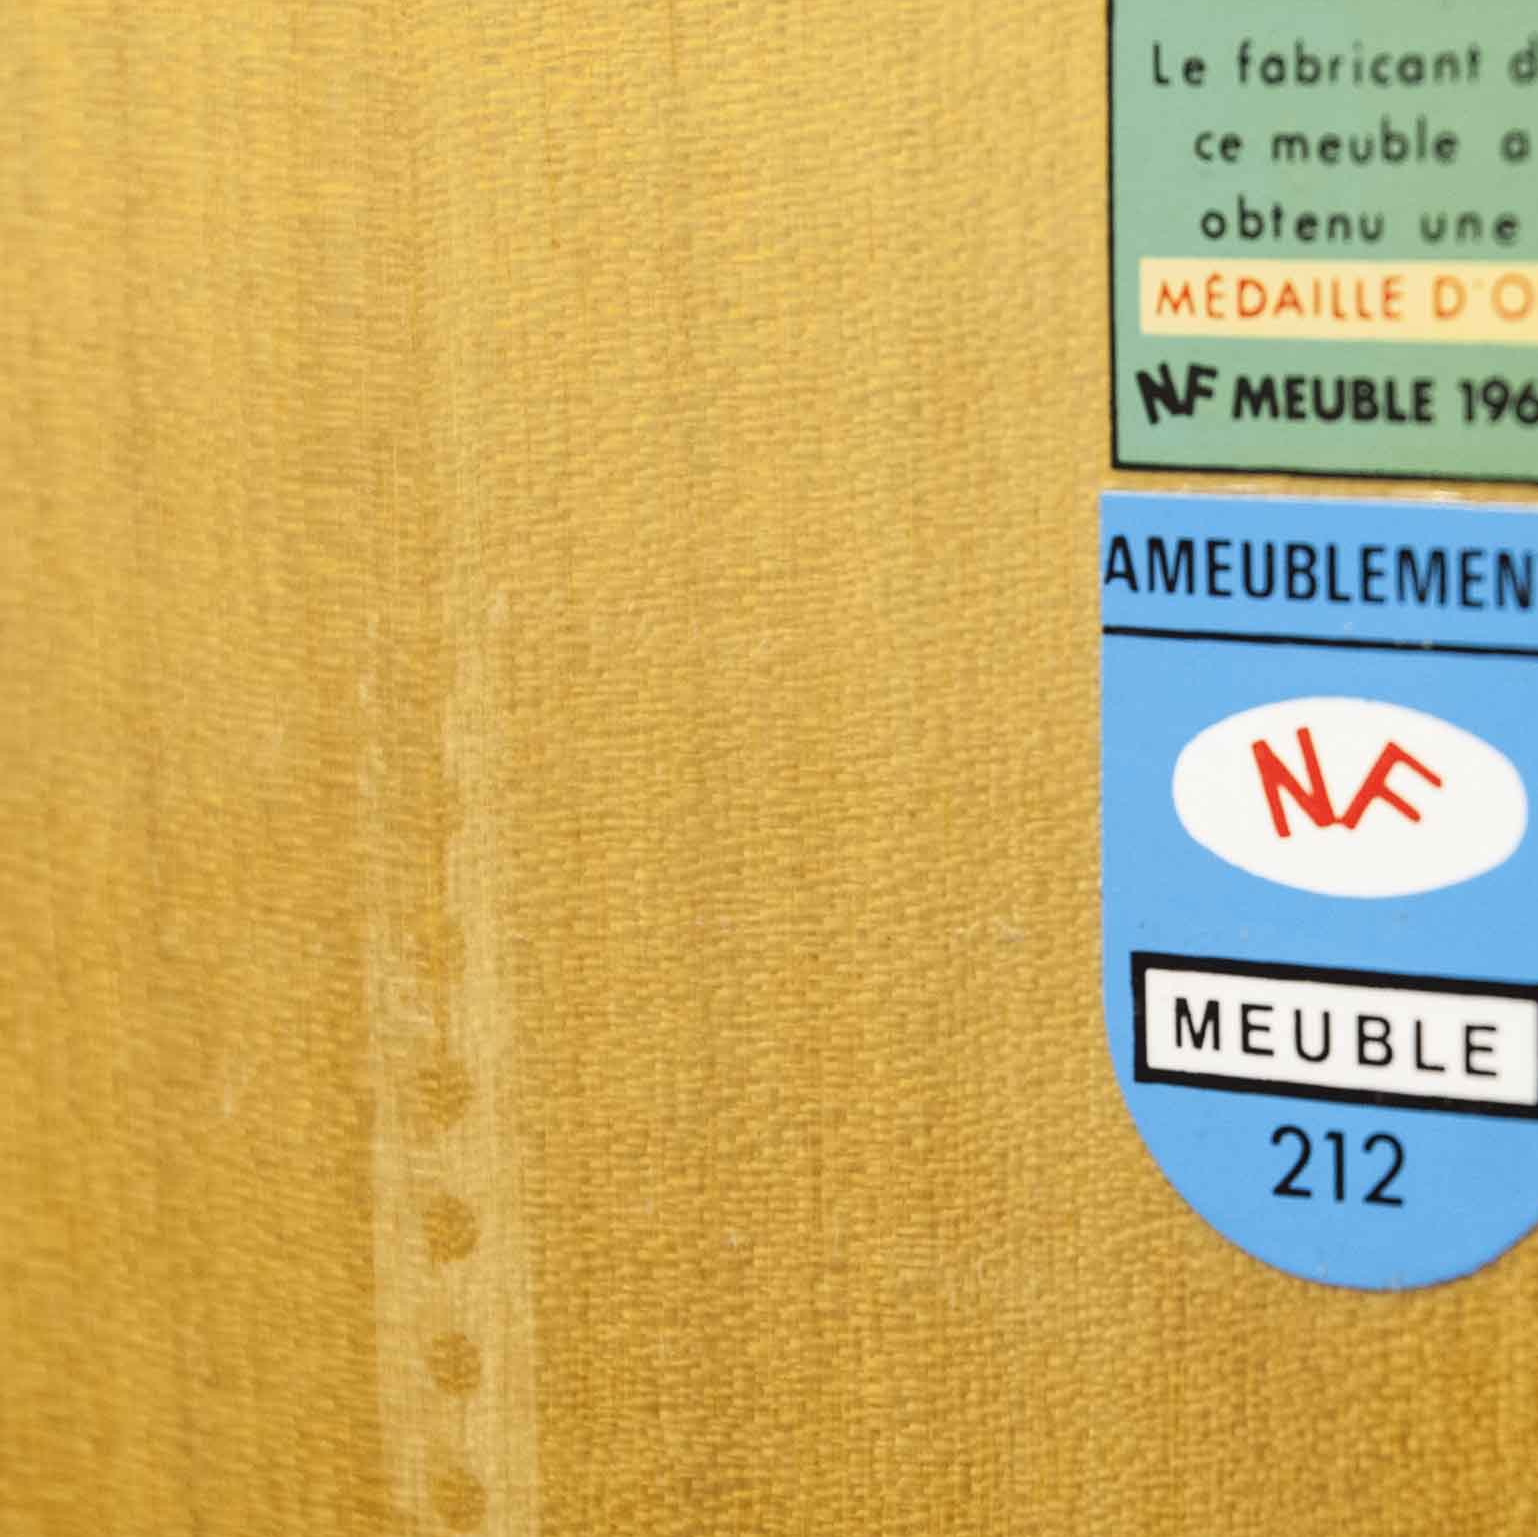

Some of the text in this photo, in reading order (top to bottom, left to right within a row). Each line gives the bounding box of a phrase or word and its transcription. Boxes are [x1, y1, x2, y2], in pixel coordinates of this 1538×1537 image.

[1152, 42, 1207, 86] Le
[1236, 37, 1481, 87] fabricant
[1194, 115, 1531, 163] ce meuble a
[1201, 194, 1520, 245] obtenu une
[1155, 273, 1407, 321] MÉDAILLE
[1135, 362, 1218, 425] NF
[1232, 375, 1435, 423] MEUBLE
[1251, 726, 1443, 838] NF
[1174, 997, 1501, 1078] MEUBLE
[1270, 1125, 1406, 1206] 212
